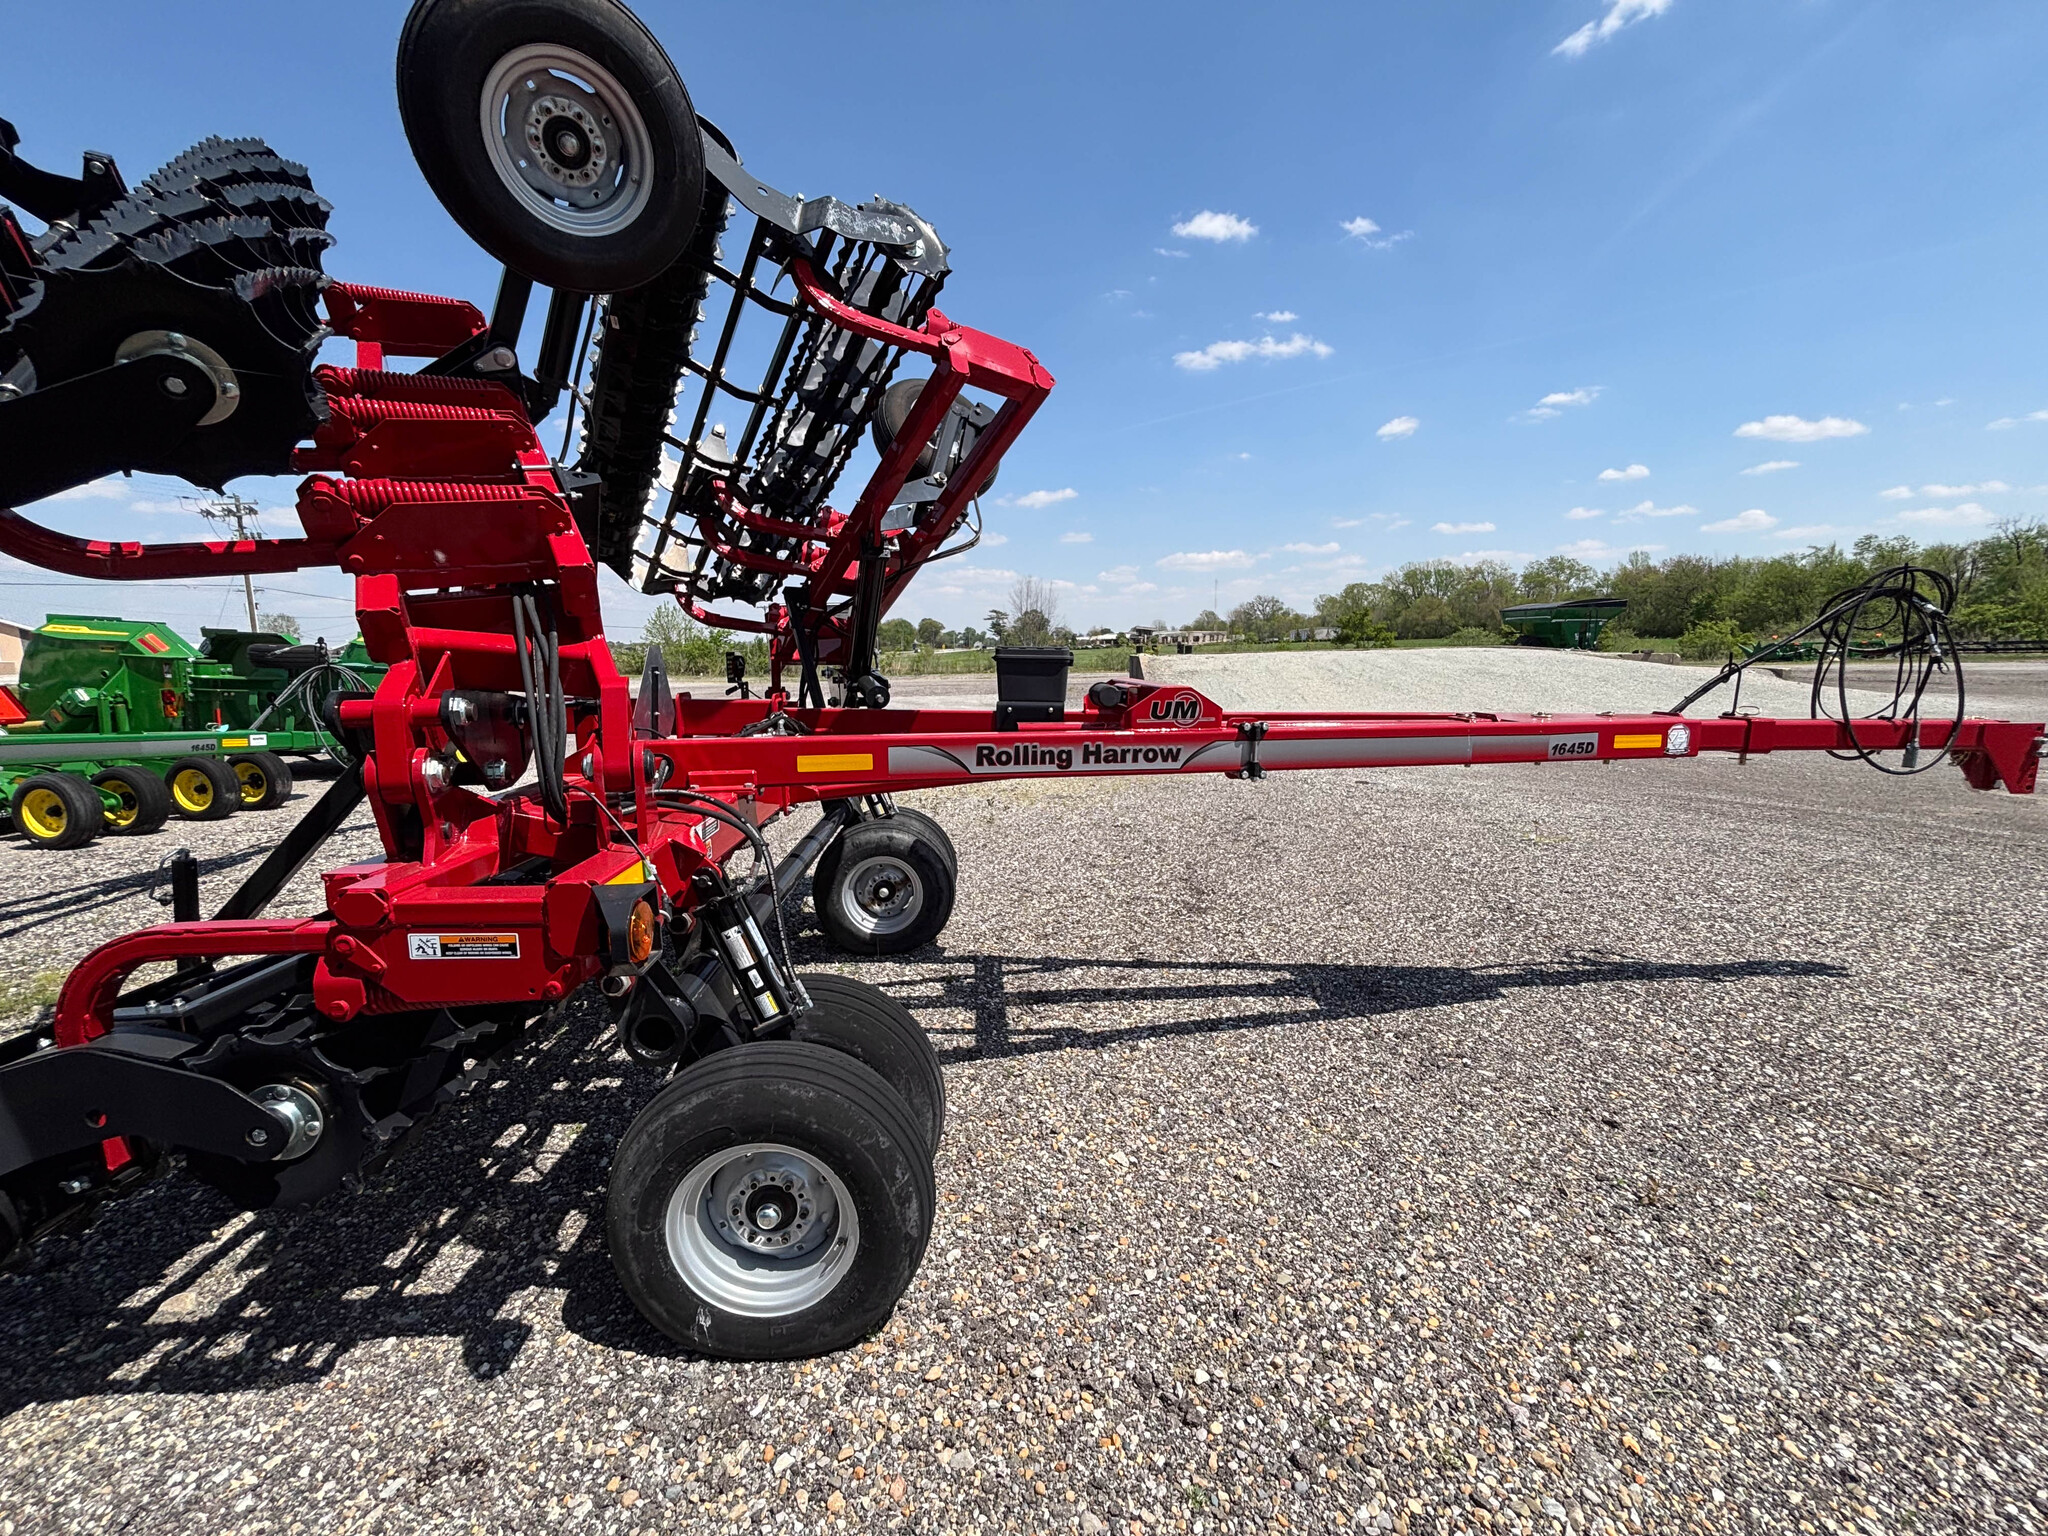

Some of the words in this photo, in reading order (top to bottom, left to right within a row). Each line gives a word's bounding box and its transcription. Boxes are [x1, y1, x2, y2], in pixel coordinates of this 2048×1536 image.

[1149, 700, 1199, 721] UM
[191, 743, 216, 752] 1645D
[975, 744, 1073, 769] Rolling
[1082, 743, 1182, 765] Harrow
[1551, 741, 1595, 756] 1645D
